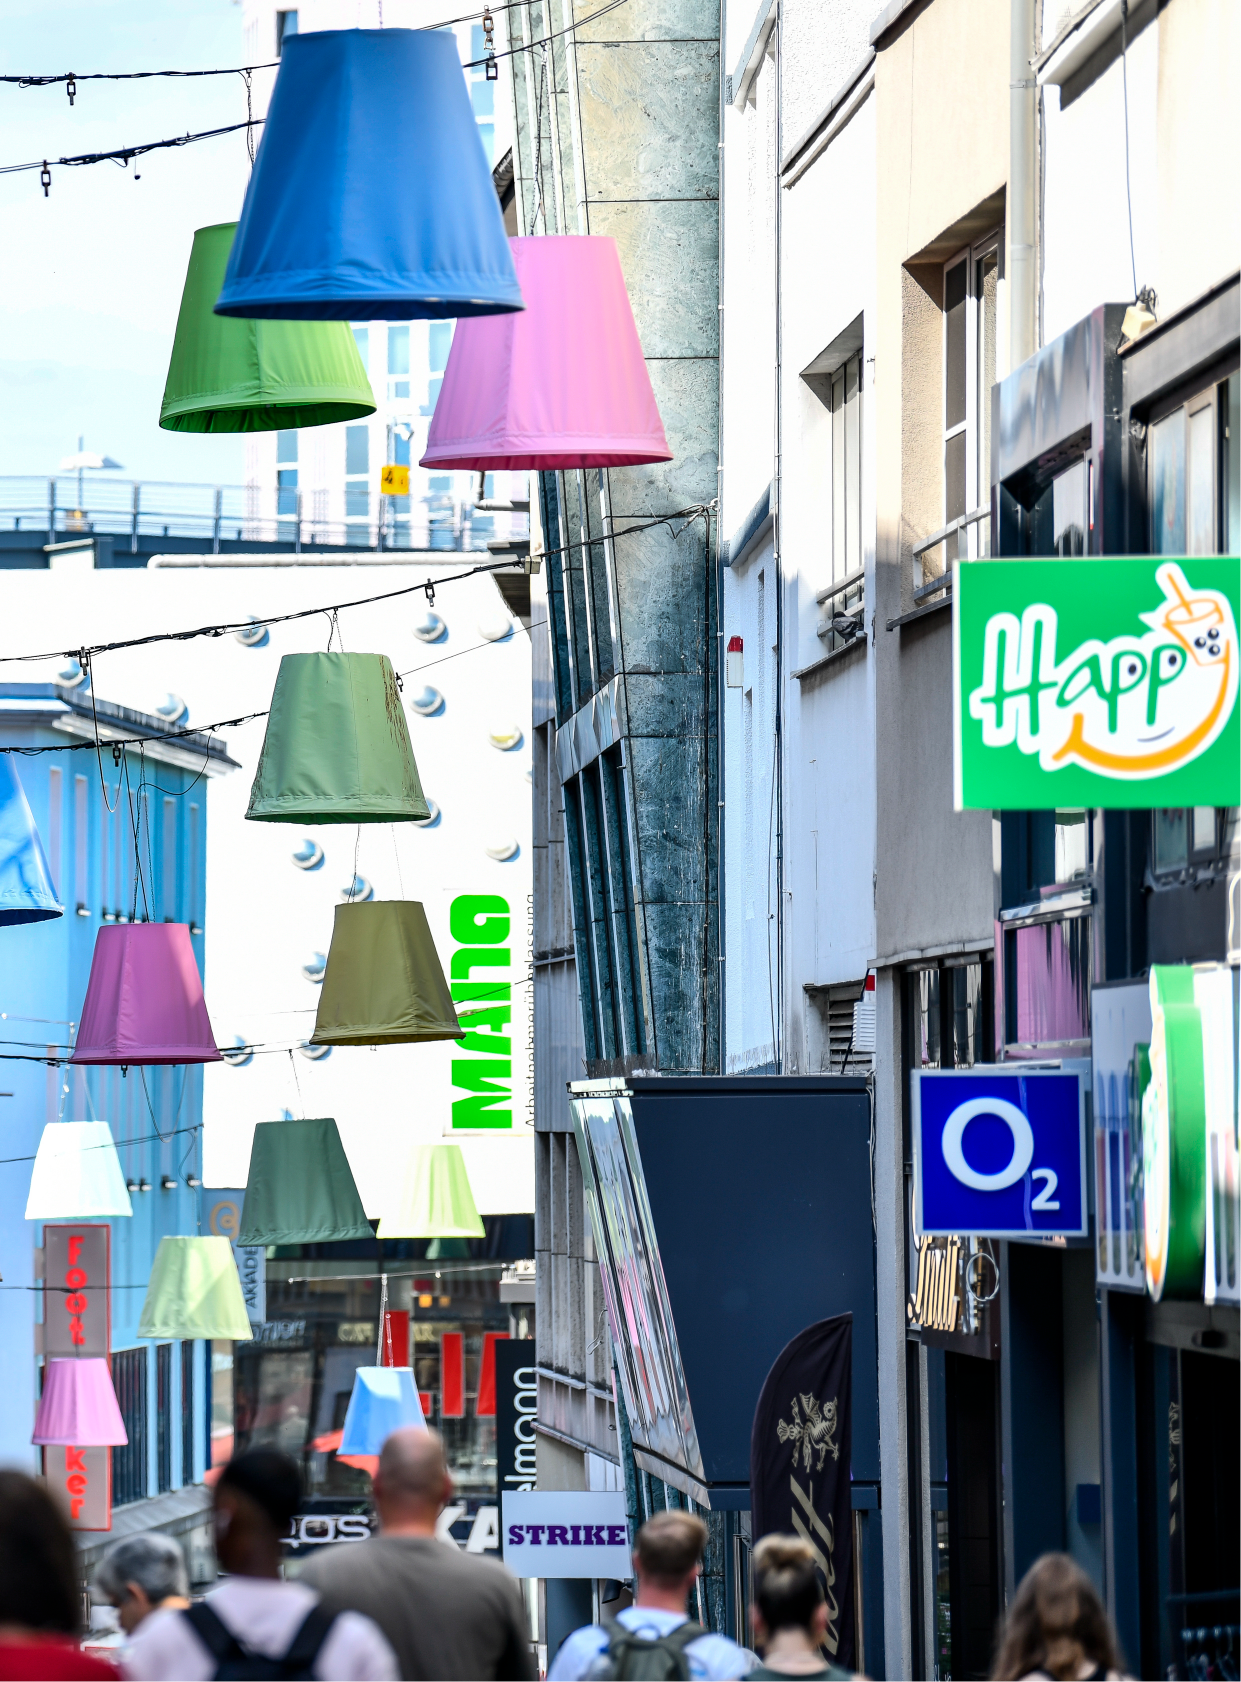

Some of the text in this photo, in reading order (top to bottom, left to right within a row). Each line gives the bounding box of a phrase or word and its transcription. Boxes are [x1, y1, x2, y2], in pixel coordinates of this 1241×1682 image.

[941, 1096, 1061, 1212] O2
[64, 1235, 89, 1346] Foot
[64, 1444, 89, 1520] ker
[508, 1524, 626, 1546] STRIKE
